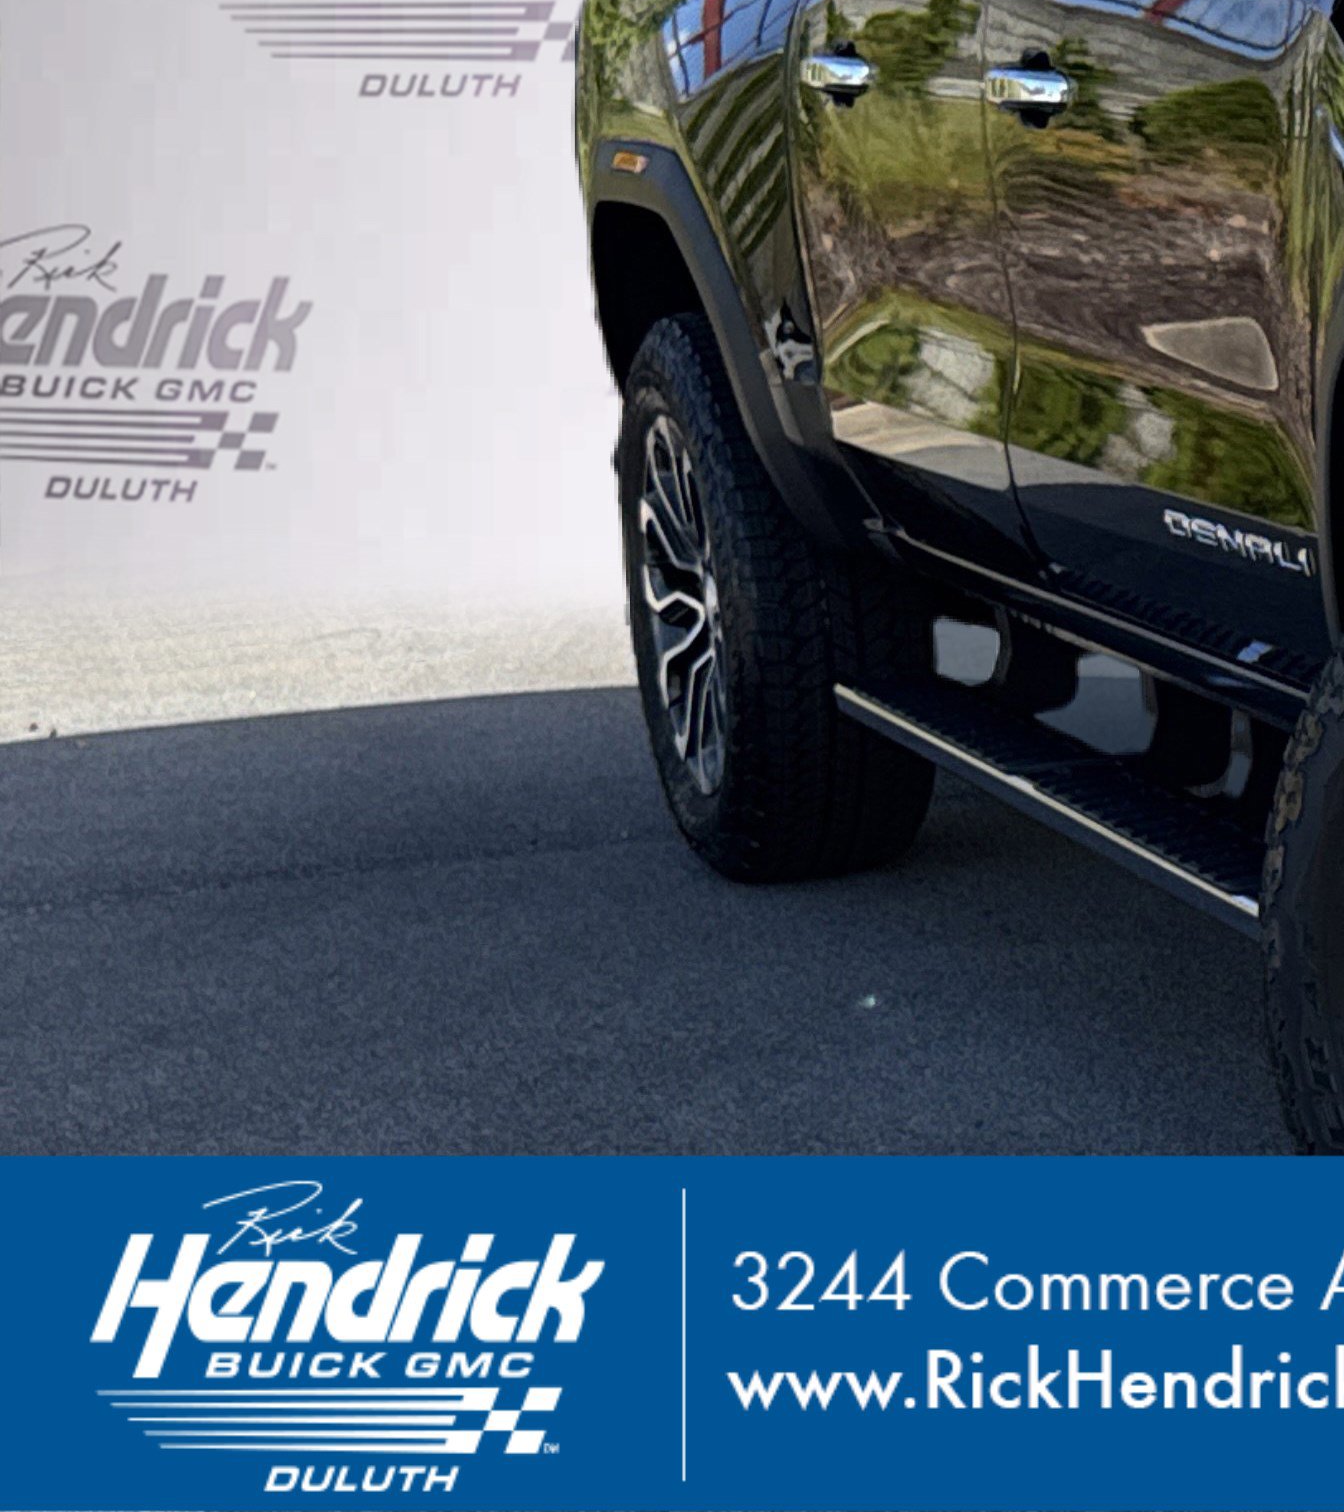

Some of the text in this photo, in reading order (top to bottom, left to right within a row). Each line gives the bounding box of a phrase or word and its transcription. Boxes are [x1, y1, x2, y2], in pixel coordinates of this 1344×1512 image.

[358, 73, 522, 98] DULUTH
[0, 273, 314, 373] endrick
[0, 372, 257, 404] BUICK GMC
[43, 475, 198, 503] DULUTH
